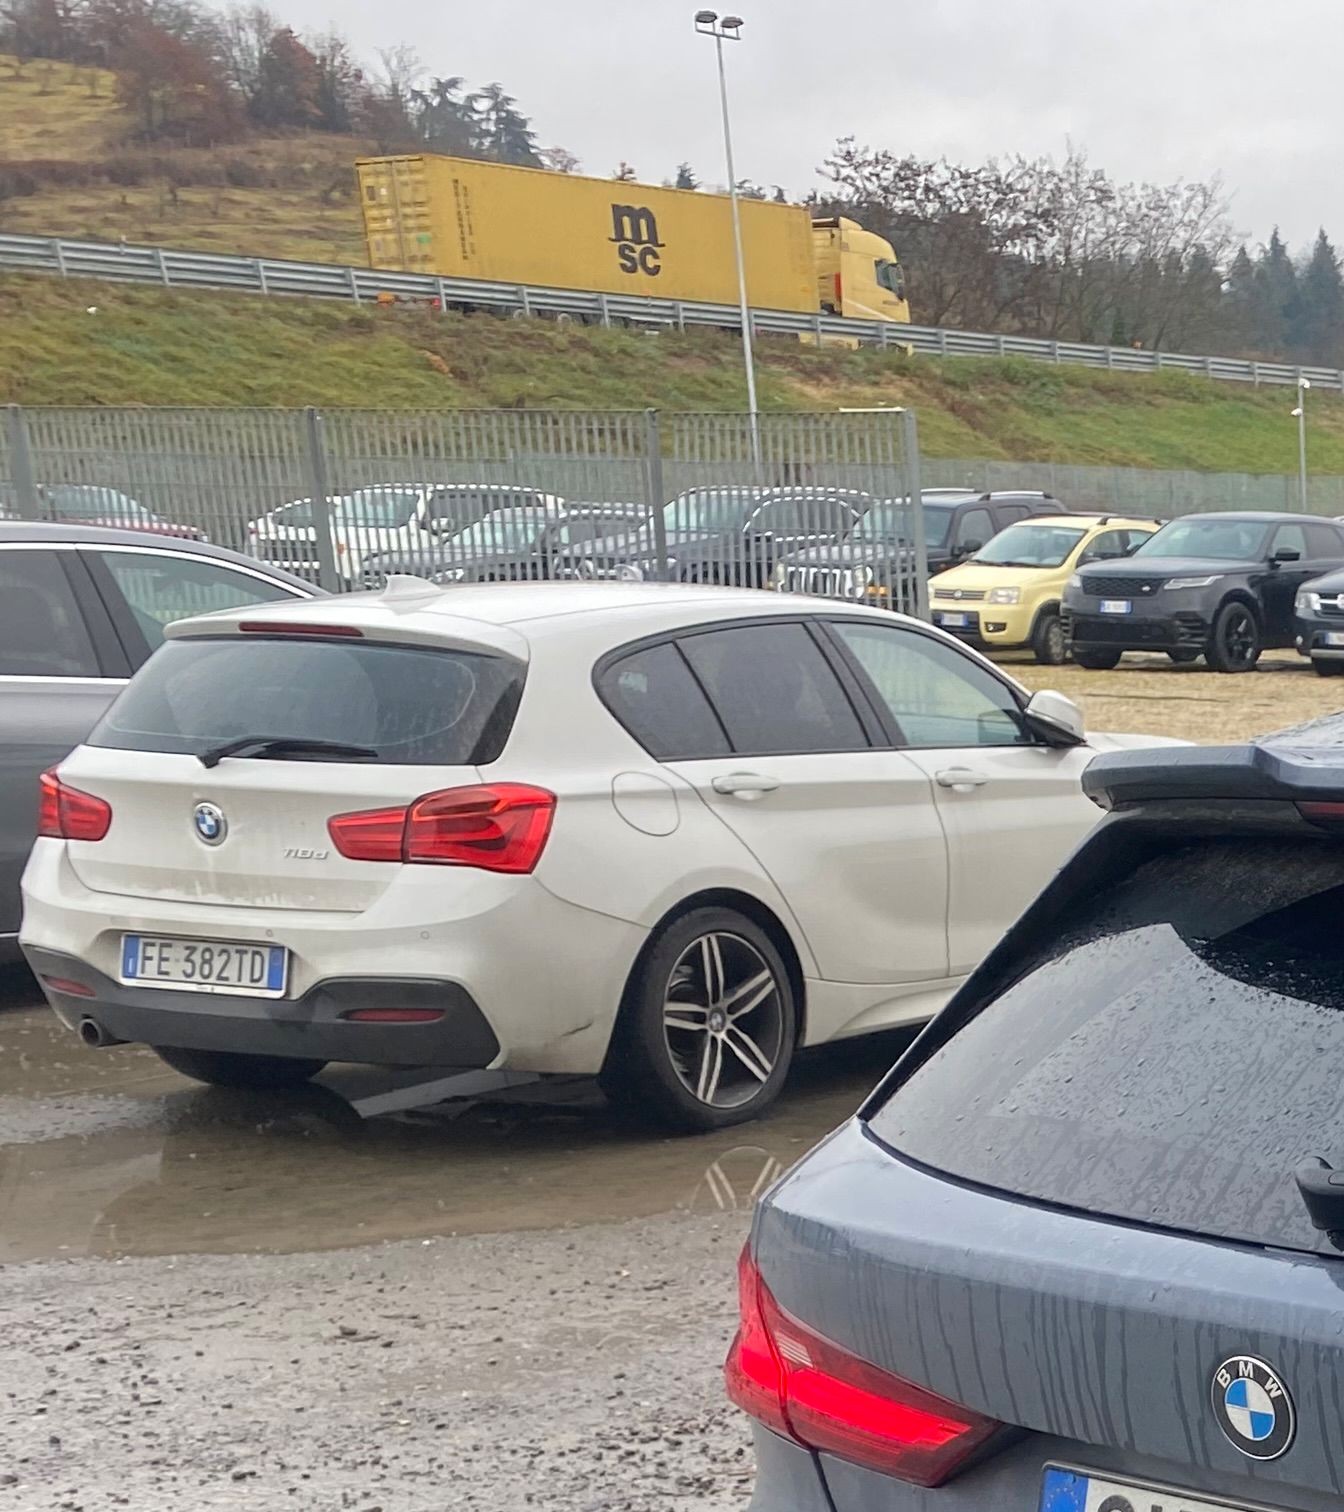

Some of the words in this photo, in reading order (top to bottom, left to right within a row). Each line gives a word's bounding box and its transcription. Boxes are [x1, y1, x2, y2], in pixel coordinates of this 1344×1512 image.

[140, 942, 173, 976] FE
[182, 945, 265, 984] 382TD
[1216, 1360, 1283, 1399] BMW
